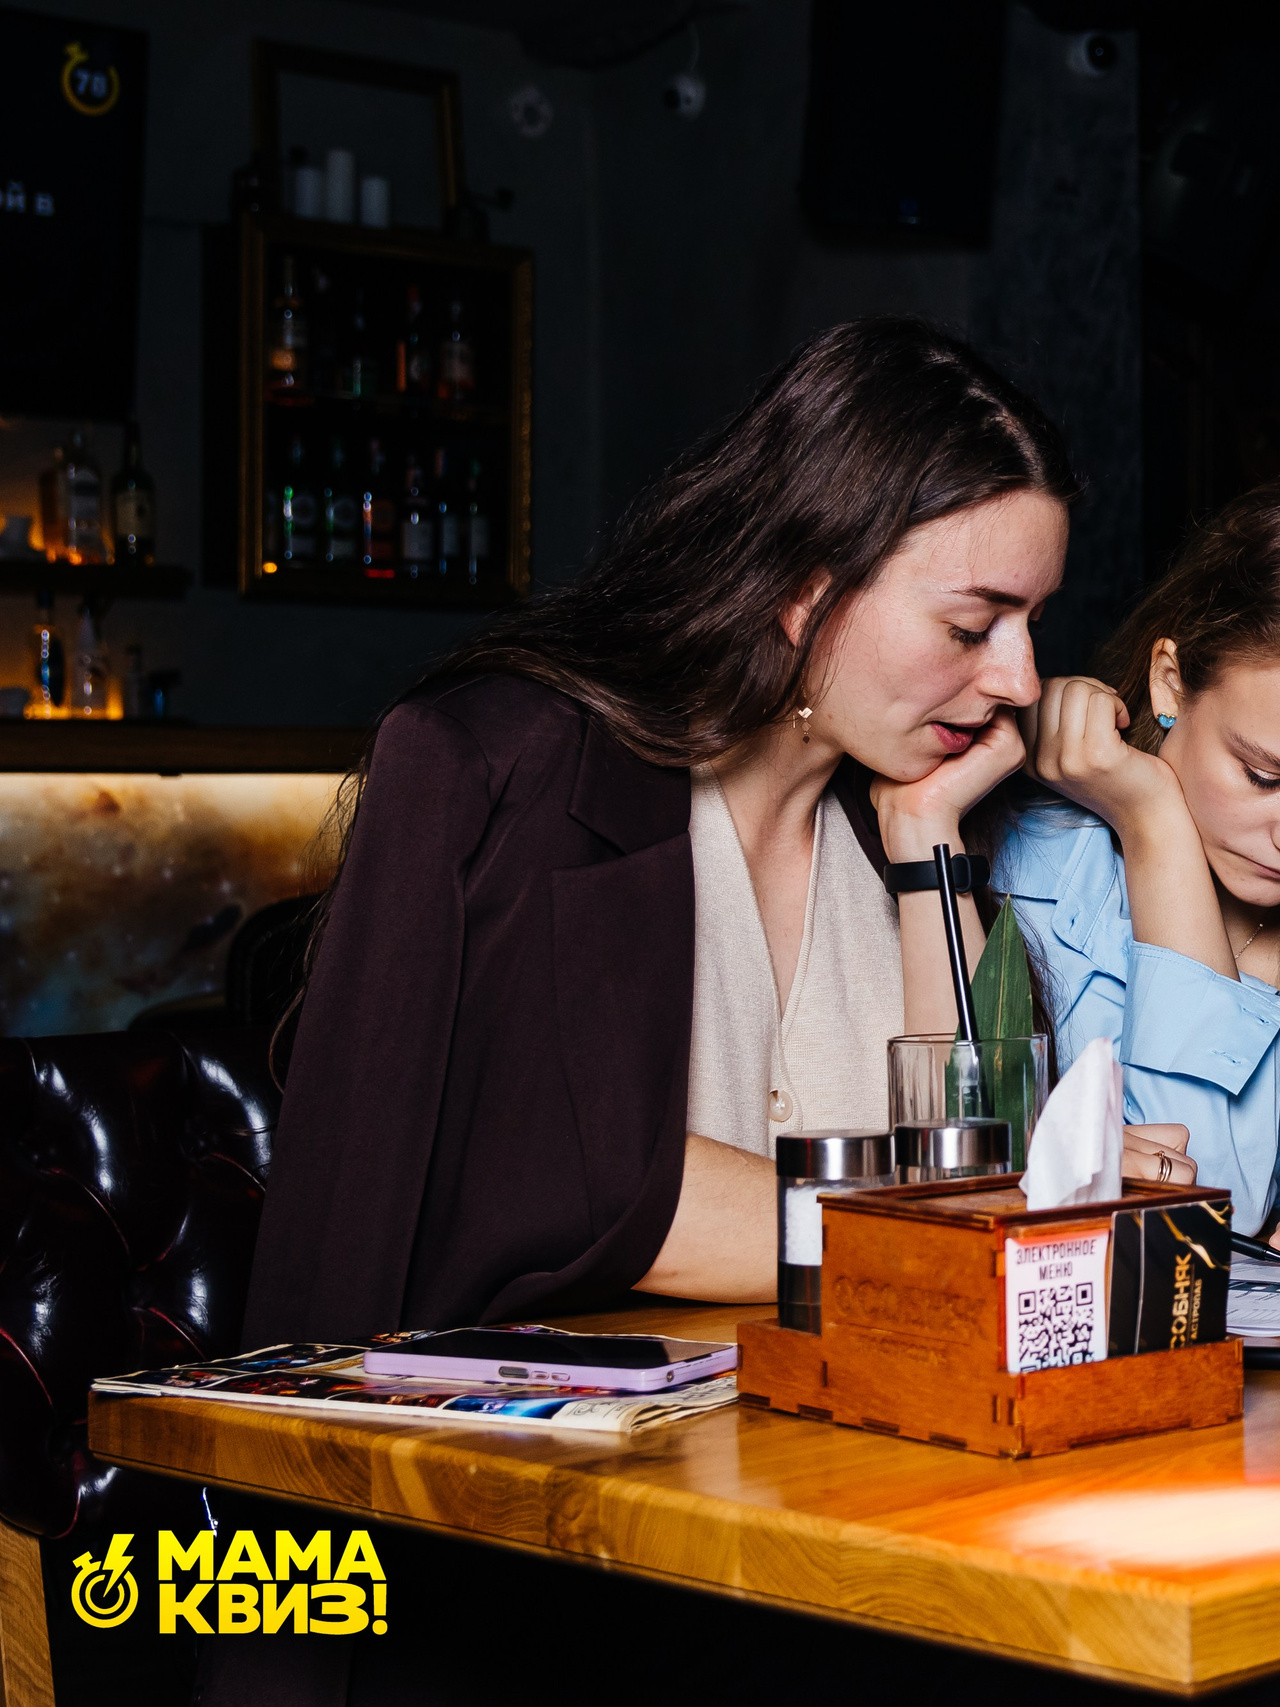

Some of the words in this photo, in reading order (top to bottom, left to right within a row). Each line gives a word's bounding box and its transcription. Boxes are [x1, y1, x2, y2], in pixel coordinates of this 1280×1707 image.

[0, 183, 25, 211] й
[1016, 1239, 1097, 1266] ЭЛЕКТРОННОЕ
[1038, 1261, 1073, 1281] МЕНЮ
